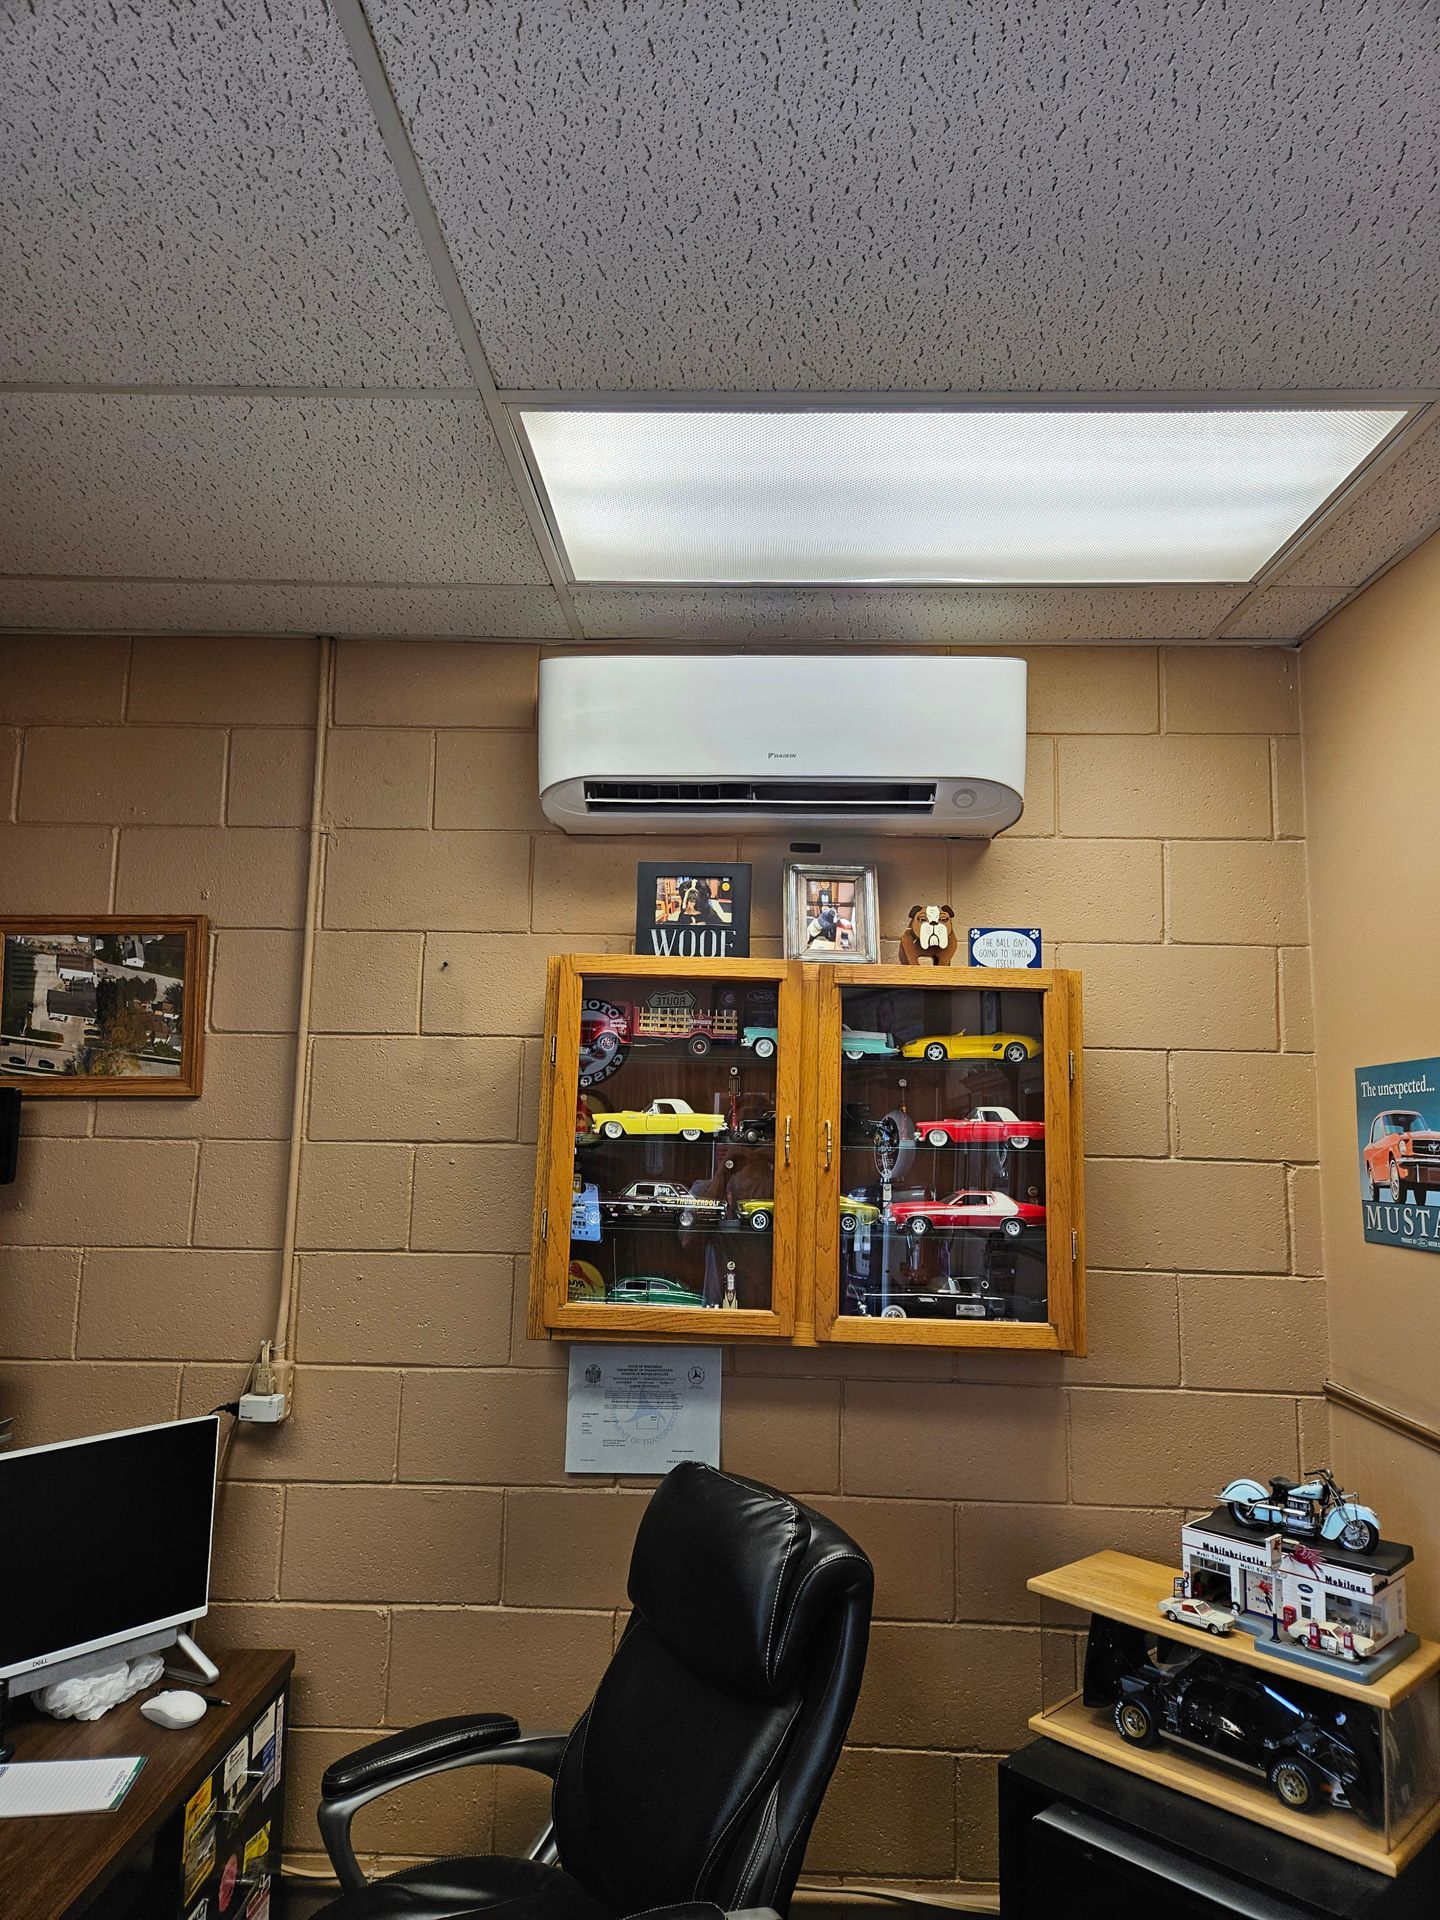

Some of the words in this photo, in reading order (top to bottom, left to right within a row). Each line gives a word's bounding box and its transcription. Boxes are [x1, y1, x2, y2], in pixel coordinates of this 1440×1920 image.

[649, 928, 737, 957] WOOF
[982, 938, 993, 947] THE
[996, 938, 1010, 947] BALL
[1013, 938, 1028, 948] ISN'T
[978, 949, 998, 958] GOING
[1001, 949, 1009, 958] TO
[1011, 949, 1032, 958] THROW
[1360, 1081, 1377, 1098] The
[1378, 1074, 1435, 1100] unexpected...
[1325, 1575, 1367, 1593] Mobilgas
[32, 1658, 48, 1668] DELL
